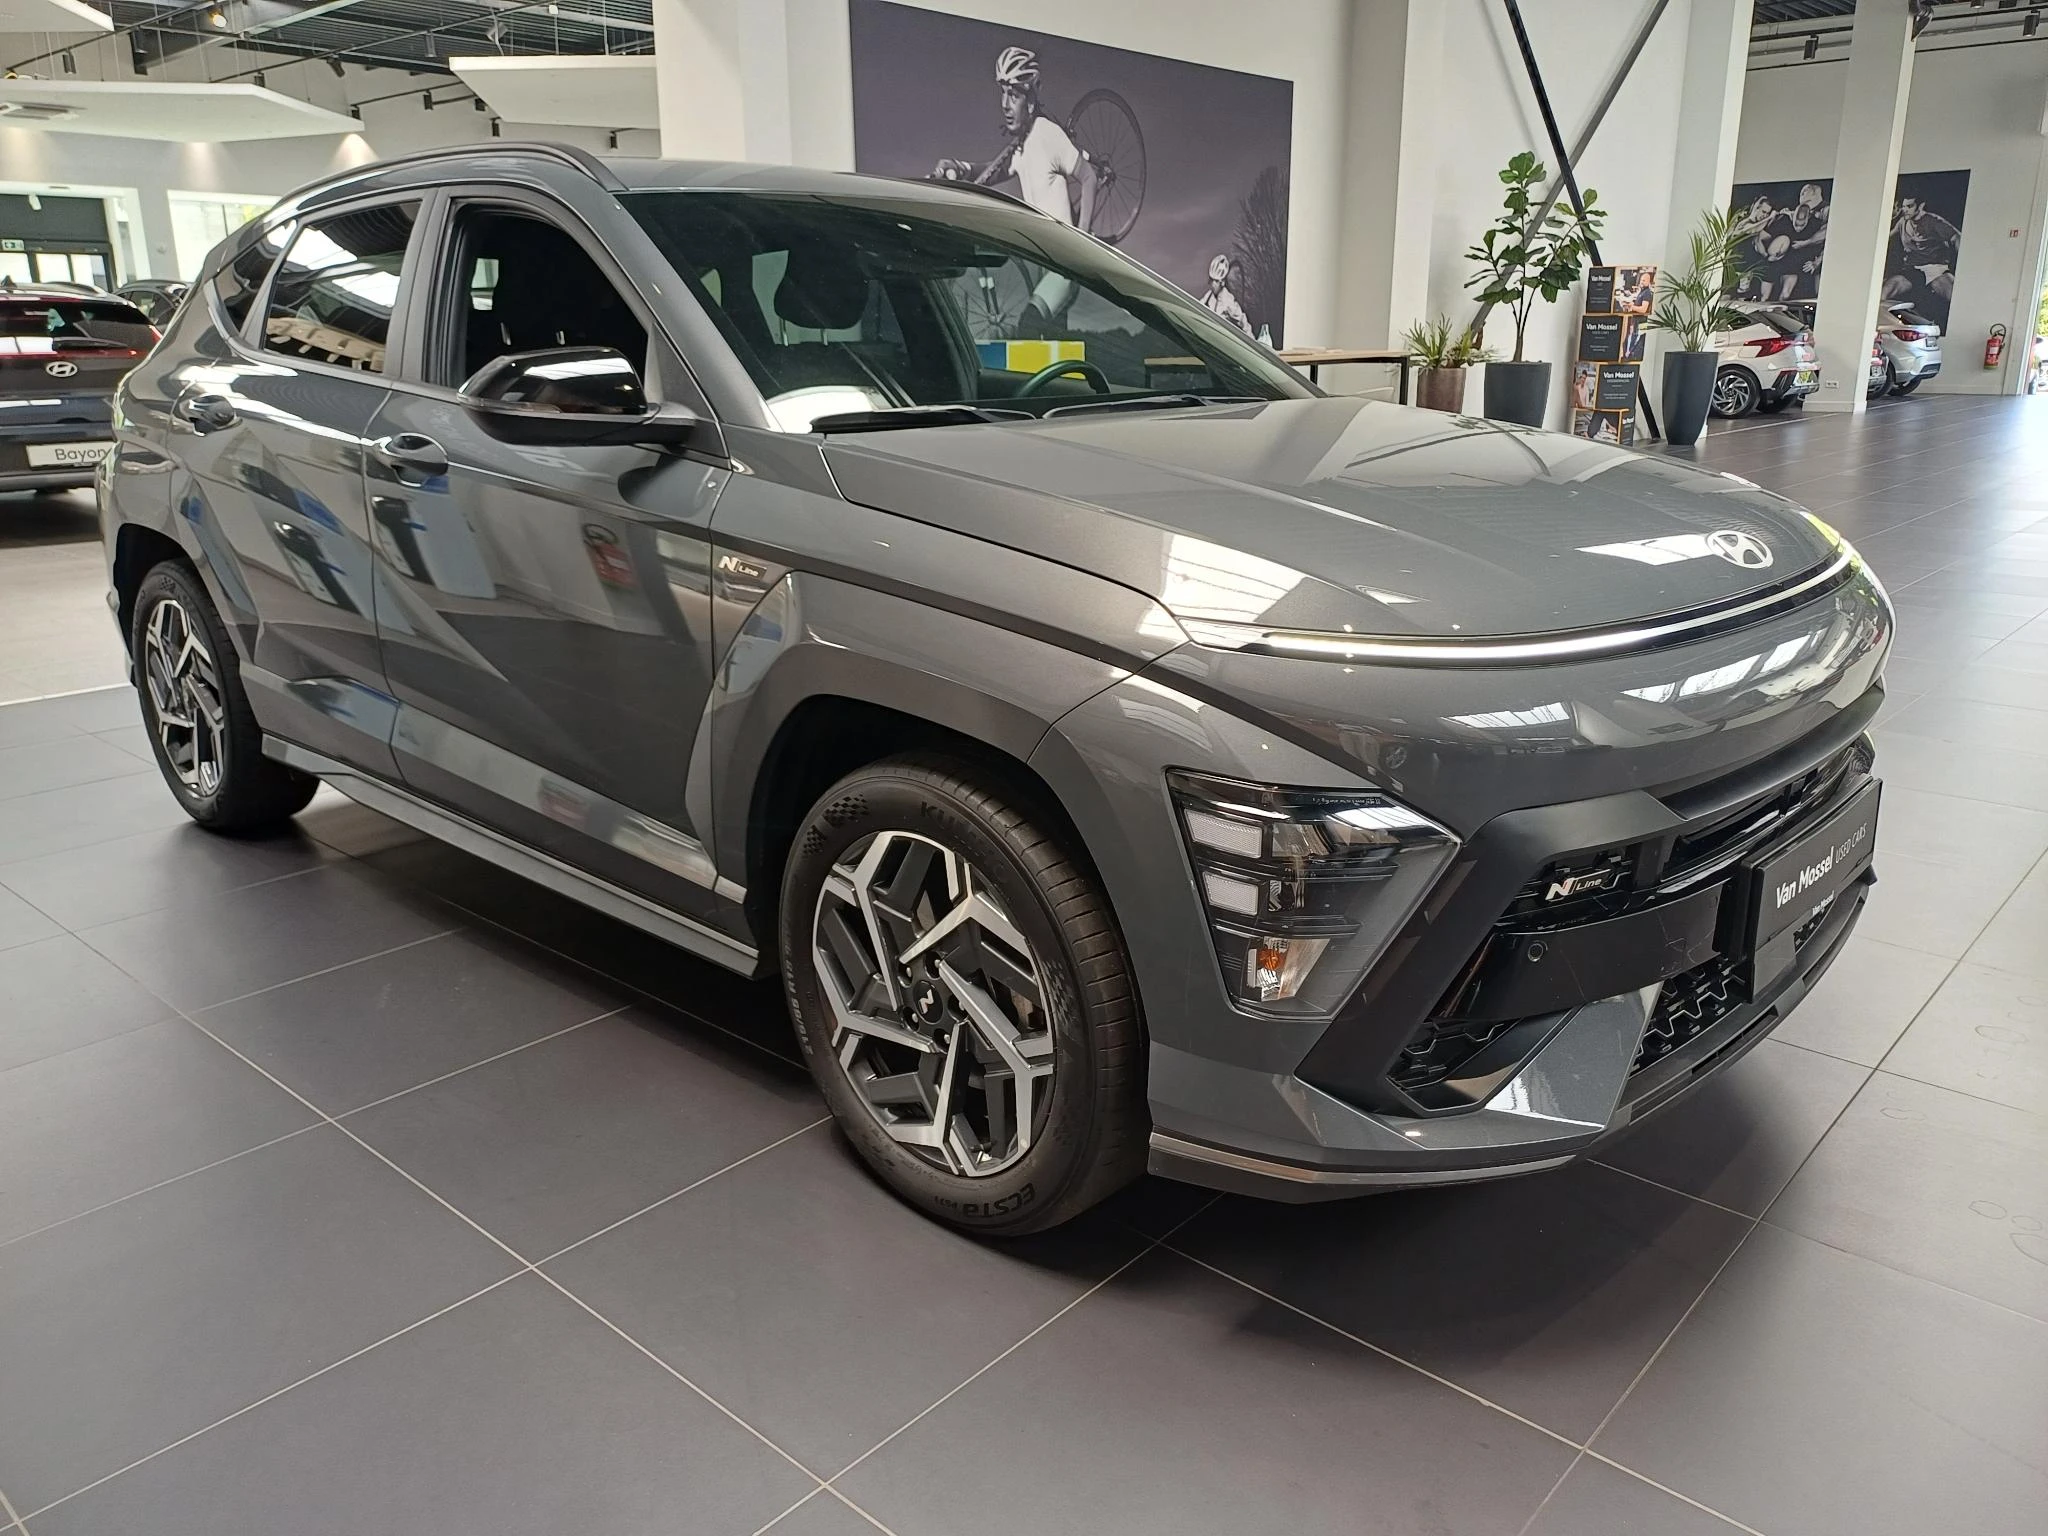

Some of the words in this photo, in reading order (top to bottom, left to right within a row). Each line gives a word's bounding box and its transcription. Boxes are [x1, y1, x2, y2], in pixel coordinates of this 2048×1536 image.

[1586, 323, 1597, 331] Van
[1597, 323, 1618, 331] Mossel
[55, 448, 107, 463] Bayon
[718, 555, 738, 573] N
[738, 565, 759, 577] Line
[1776, 881, 1797, 909] Van
[1798, 845, 1835, 894] Mossel
[1835, 838, 1852, 864] USED
[1851, 822, 1868, 848] CARS
[1545, 877, 1576, 900] N
[1575, 879, 1602, 891] Line
